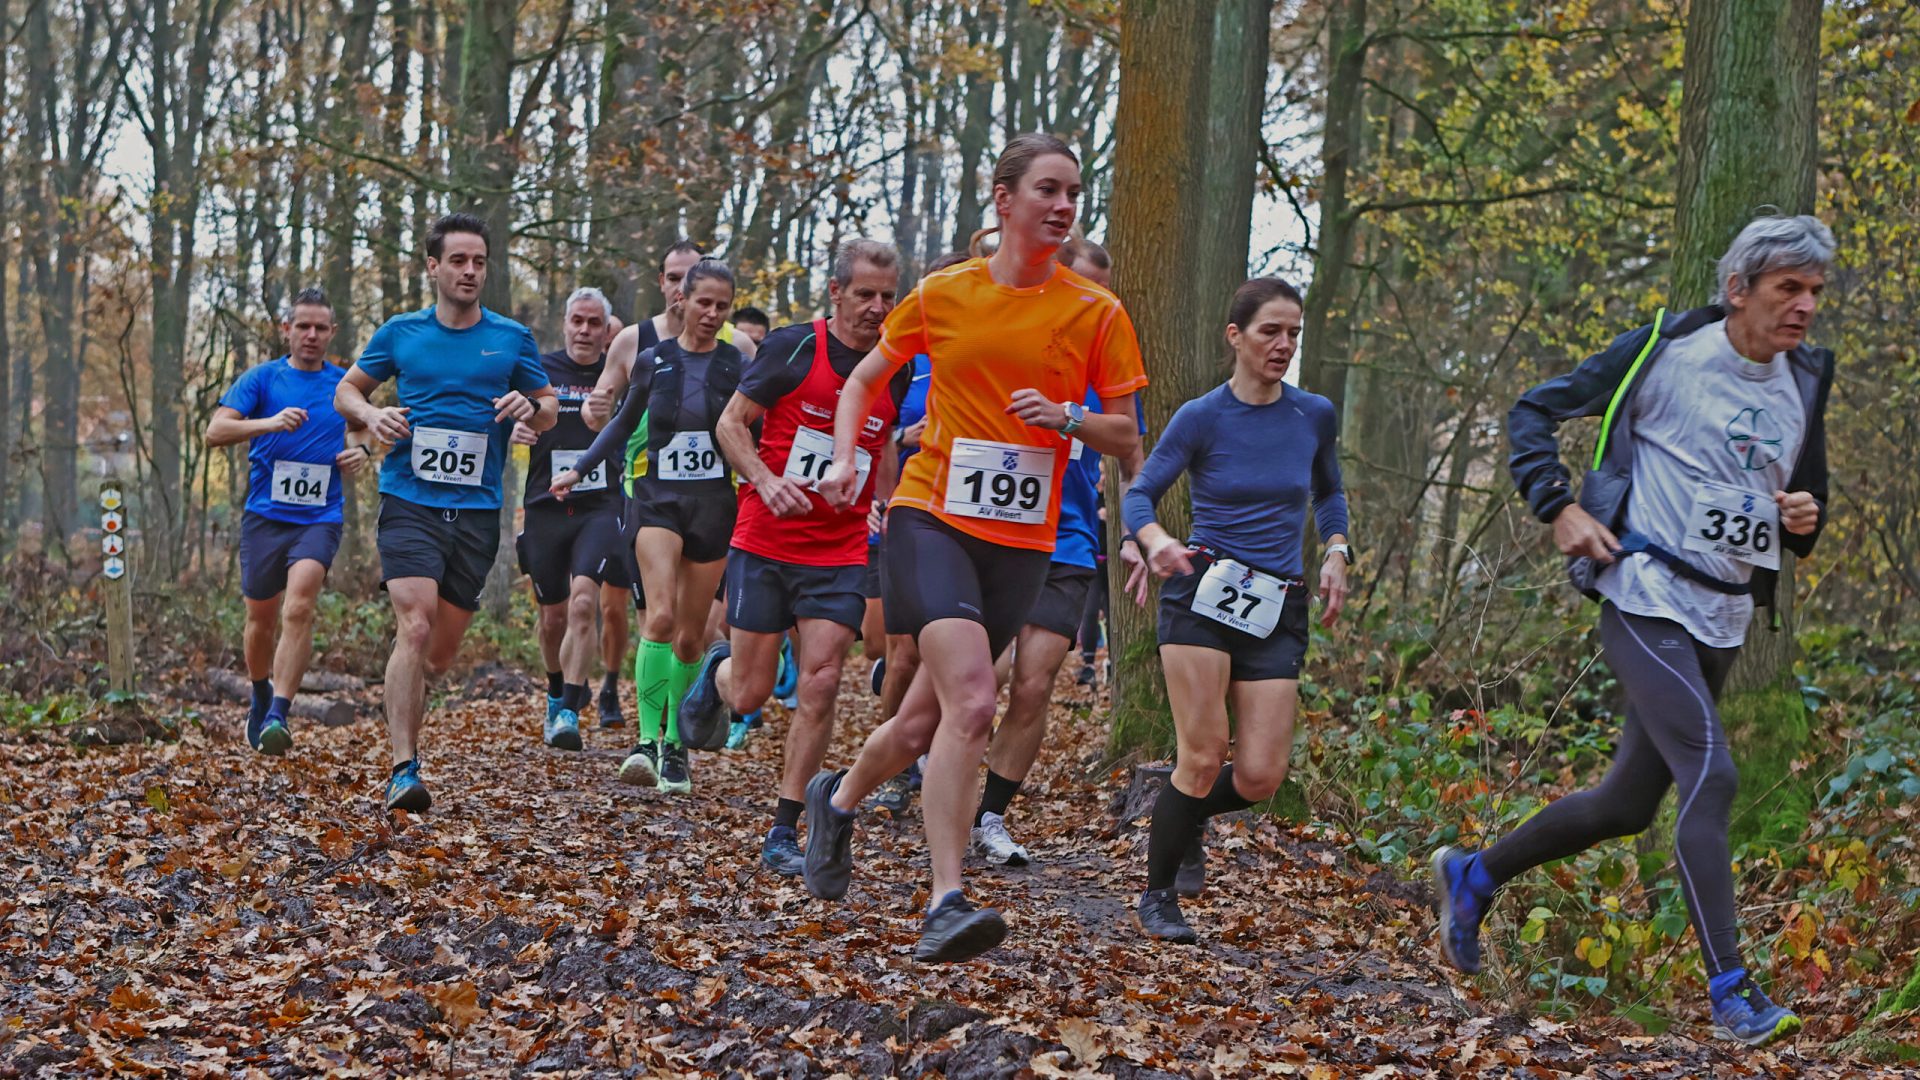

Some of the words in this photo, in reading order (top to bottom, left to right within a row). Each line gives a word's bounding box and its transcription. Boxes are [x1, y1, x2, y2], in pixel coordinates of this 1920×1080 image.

[419, 448, 477, 476] 205
[667, 450, 716, 472] 130
[280, 476, 322, 499] 104
[963, 470, 1041, 510] 199
[978, 506, 993, 515] AV
[994, 508, 1022, 519] Weert
[1700, 509, 1771, 553] 336
[1216, 585, 1262, 619] 27
[1216, 612, 1226, 621] AV
[1228, 616, 1250, 630] Weert
